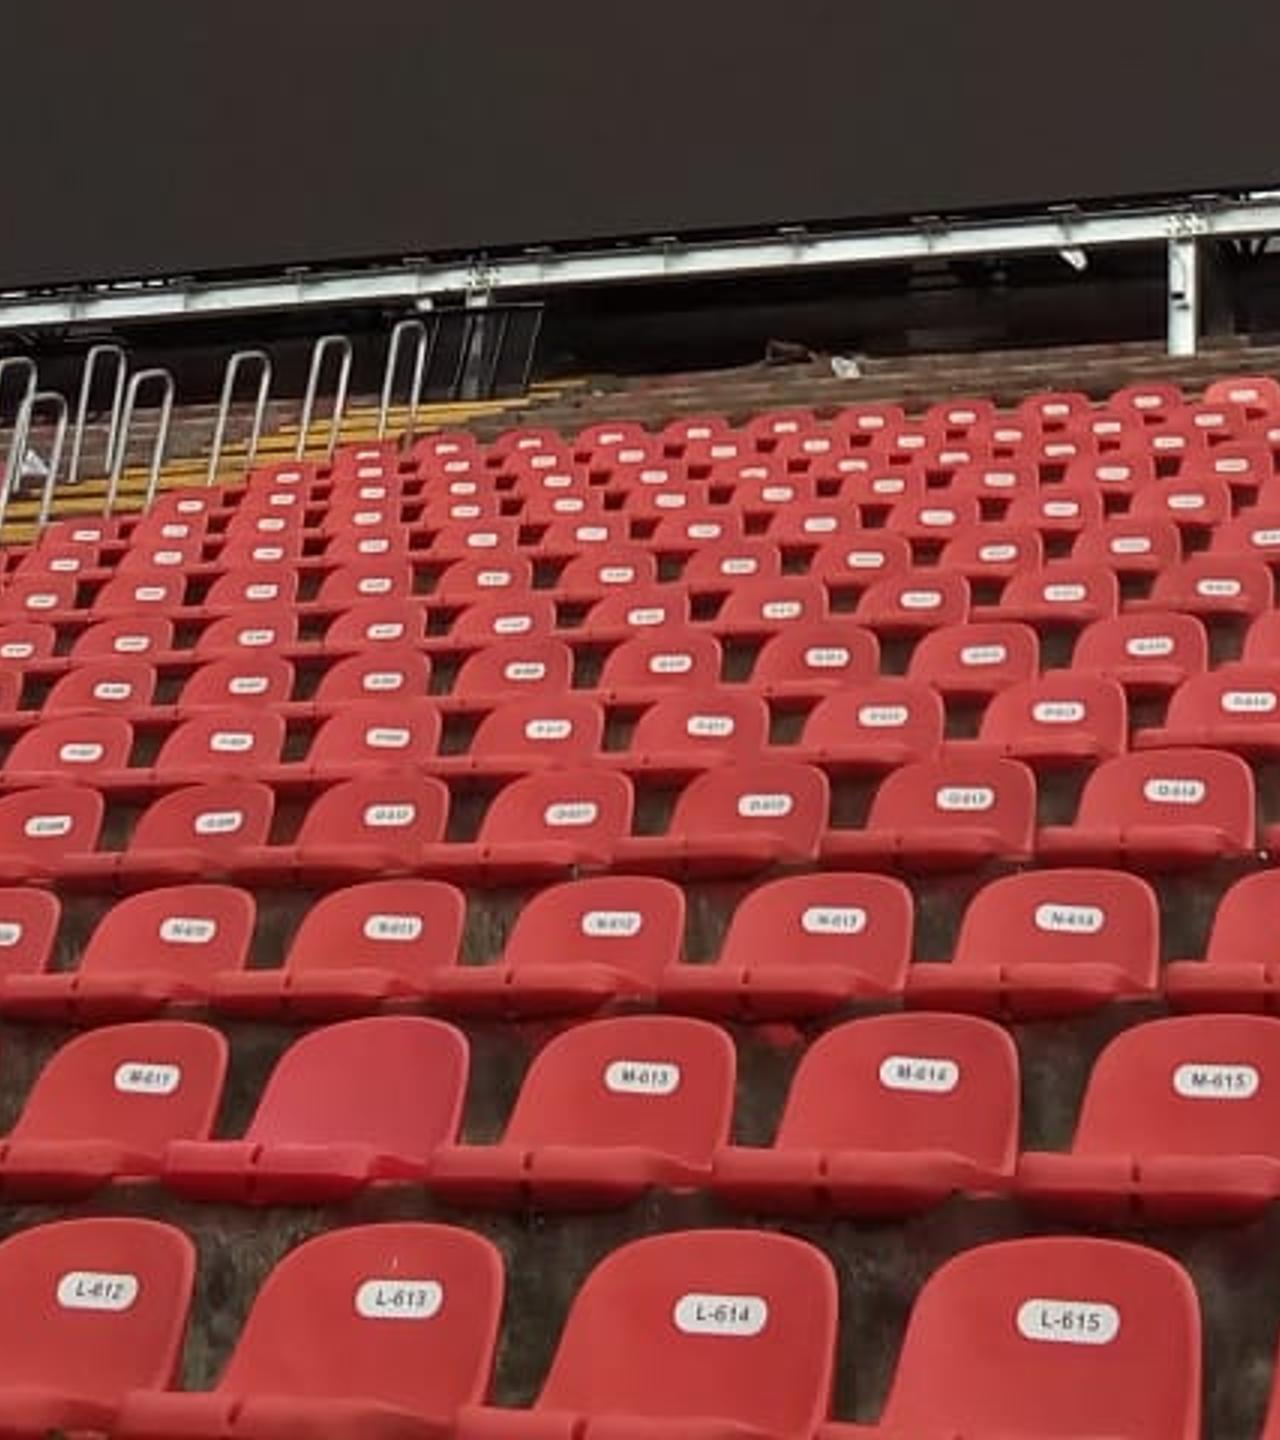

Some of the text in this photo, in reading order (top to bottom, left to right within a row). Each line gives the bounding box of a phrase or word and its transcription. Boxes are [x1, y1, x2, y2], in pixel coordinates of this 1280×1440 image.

[1191, 1072, 1245, 1088] M-615
[75, 1279, 125, 1300] L-612
[375, 1288, 427, 1307] L-613
[696, 1304, 749, 1322] L-614
[1040, 1309, 1100, 1332] L-615
